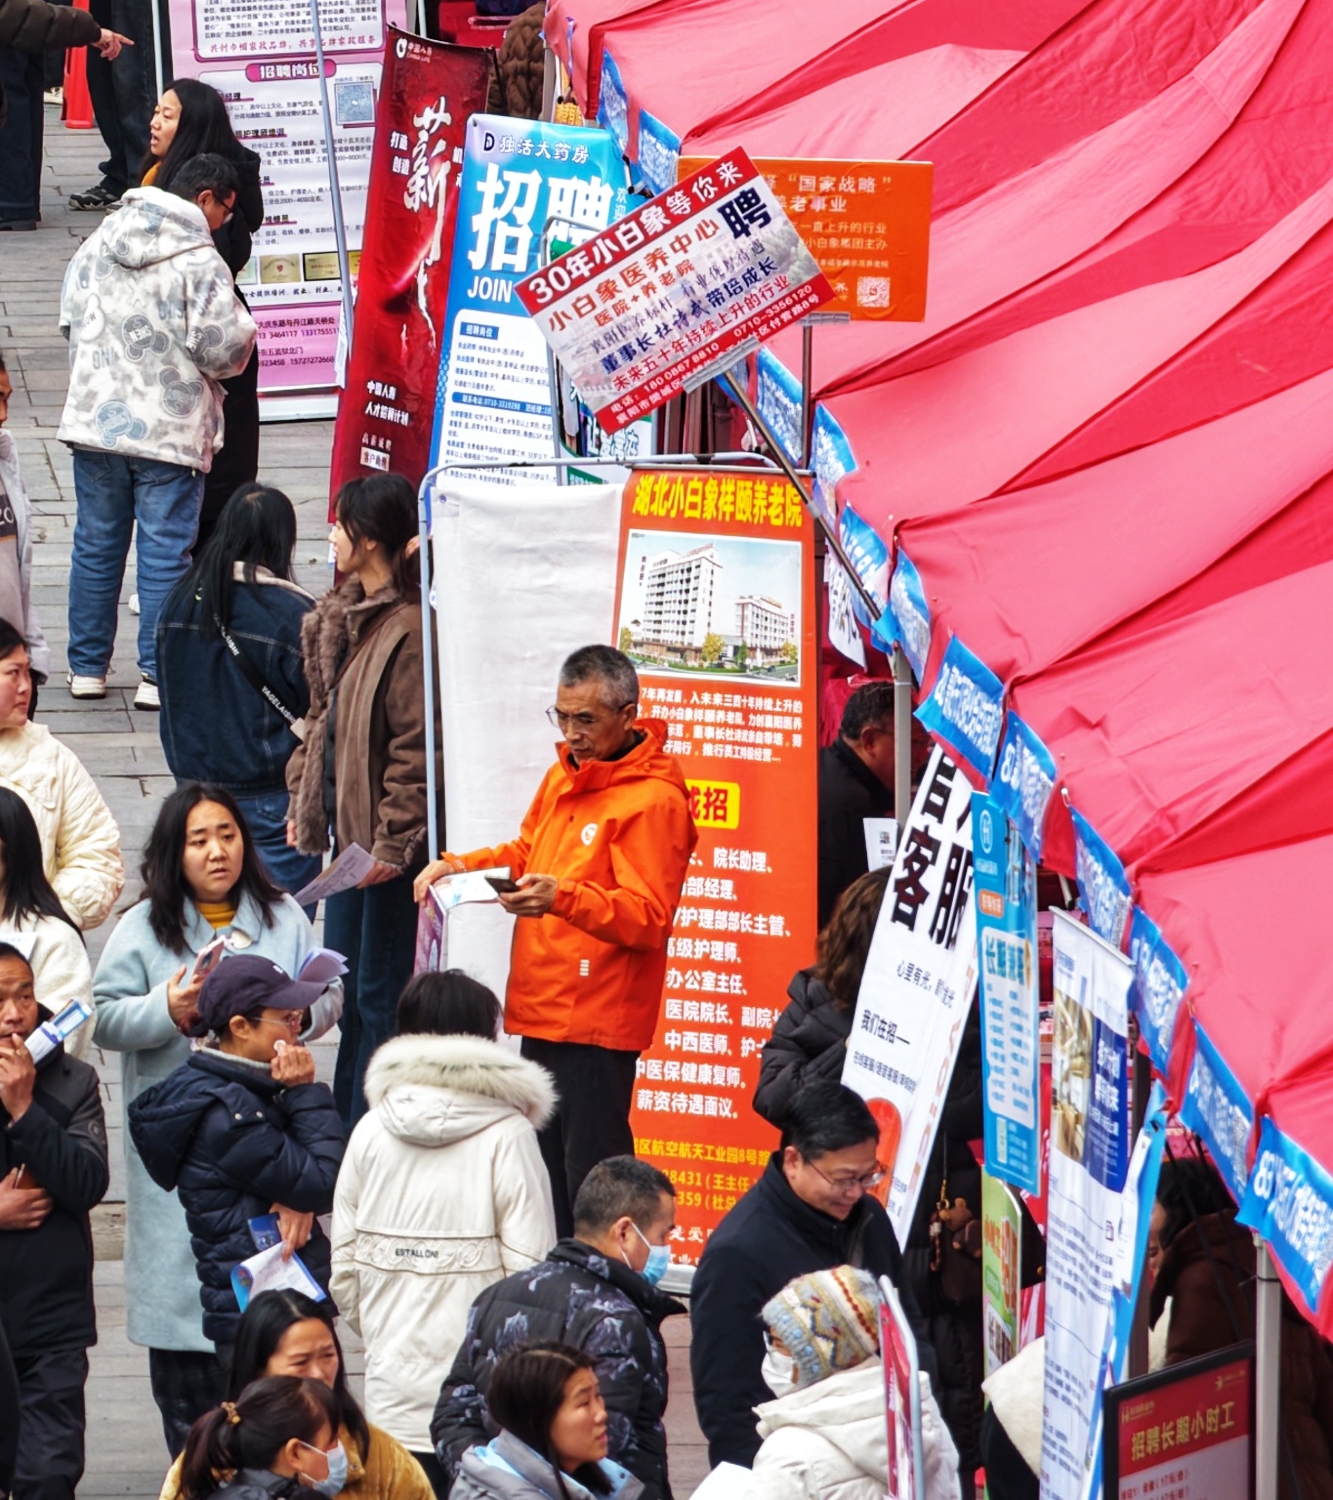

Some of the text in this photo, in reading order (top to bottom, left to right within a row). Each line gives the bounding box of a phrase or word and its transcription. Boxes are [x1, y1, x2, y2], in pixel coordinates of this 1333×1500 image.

[499, 135, 591, 165] 独活大药房
[467, 161, 615, 276] 招聘
[527, 158, 745, 304] 30年小白象等你来
[716, 185, 772, 241] 聘
[804, 237, 889, 251] 小白象集团主办
[467, 274, 514, 304] JOIN
[547, 215, 721, 335] 小白象医养中心
[612, 274, 791, 393] 未来五十年持续上升的行业
[632, 473, 803, 528] 湖北小白象祥颐养老院
[680, 876, 739, 903] 部经理、
[666, 966, 749, 997] 办公室主任、
[636, 1087, 739, 1120] 薪资待遇面议。
[1131, 1400, 1236, 1462] 招聘长期小时工
